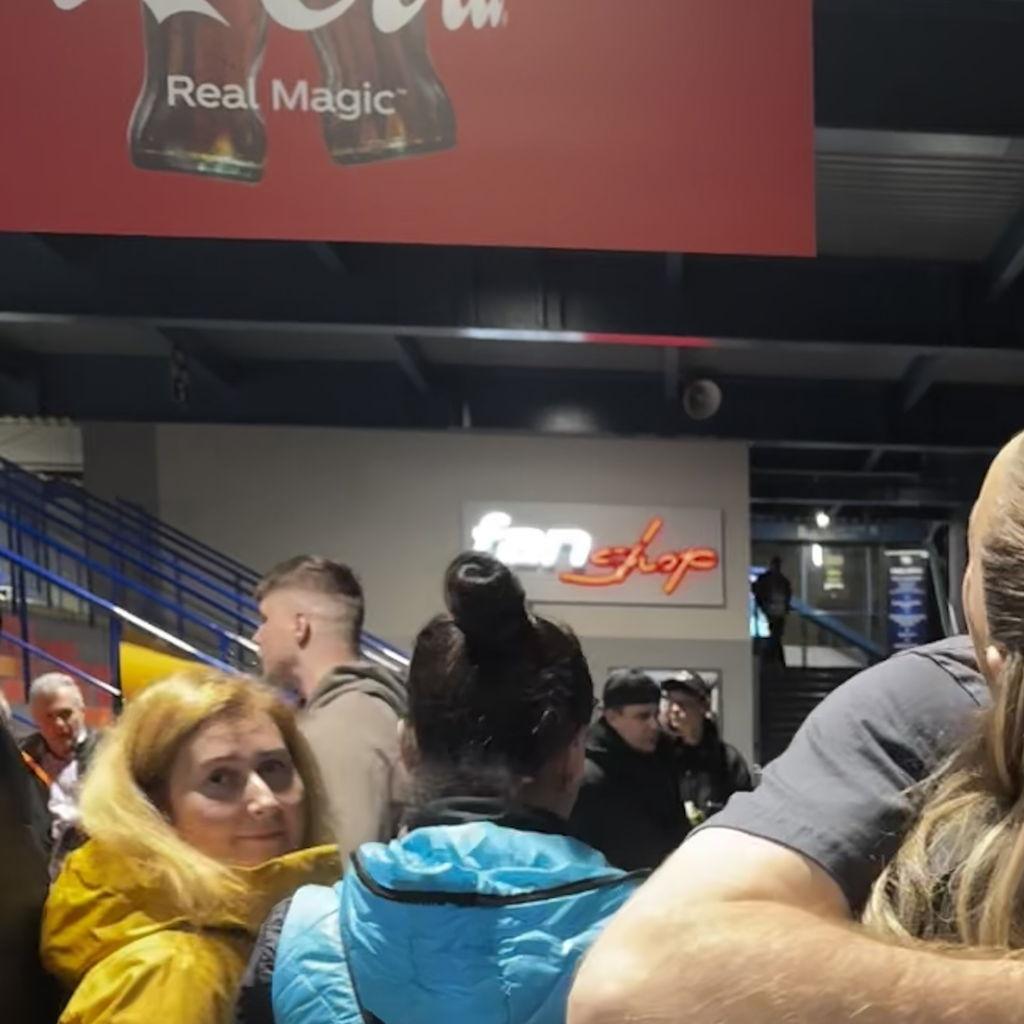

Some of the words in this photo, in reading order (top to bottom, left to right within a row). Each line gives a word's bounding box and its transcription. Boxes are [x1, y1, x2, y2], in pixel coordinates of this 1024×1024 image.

[166, 75, 260, 110] Real
[470, 509, 592, 568] fan
[559, 516, 720, 596] shop
